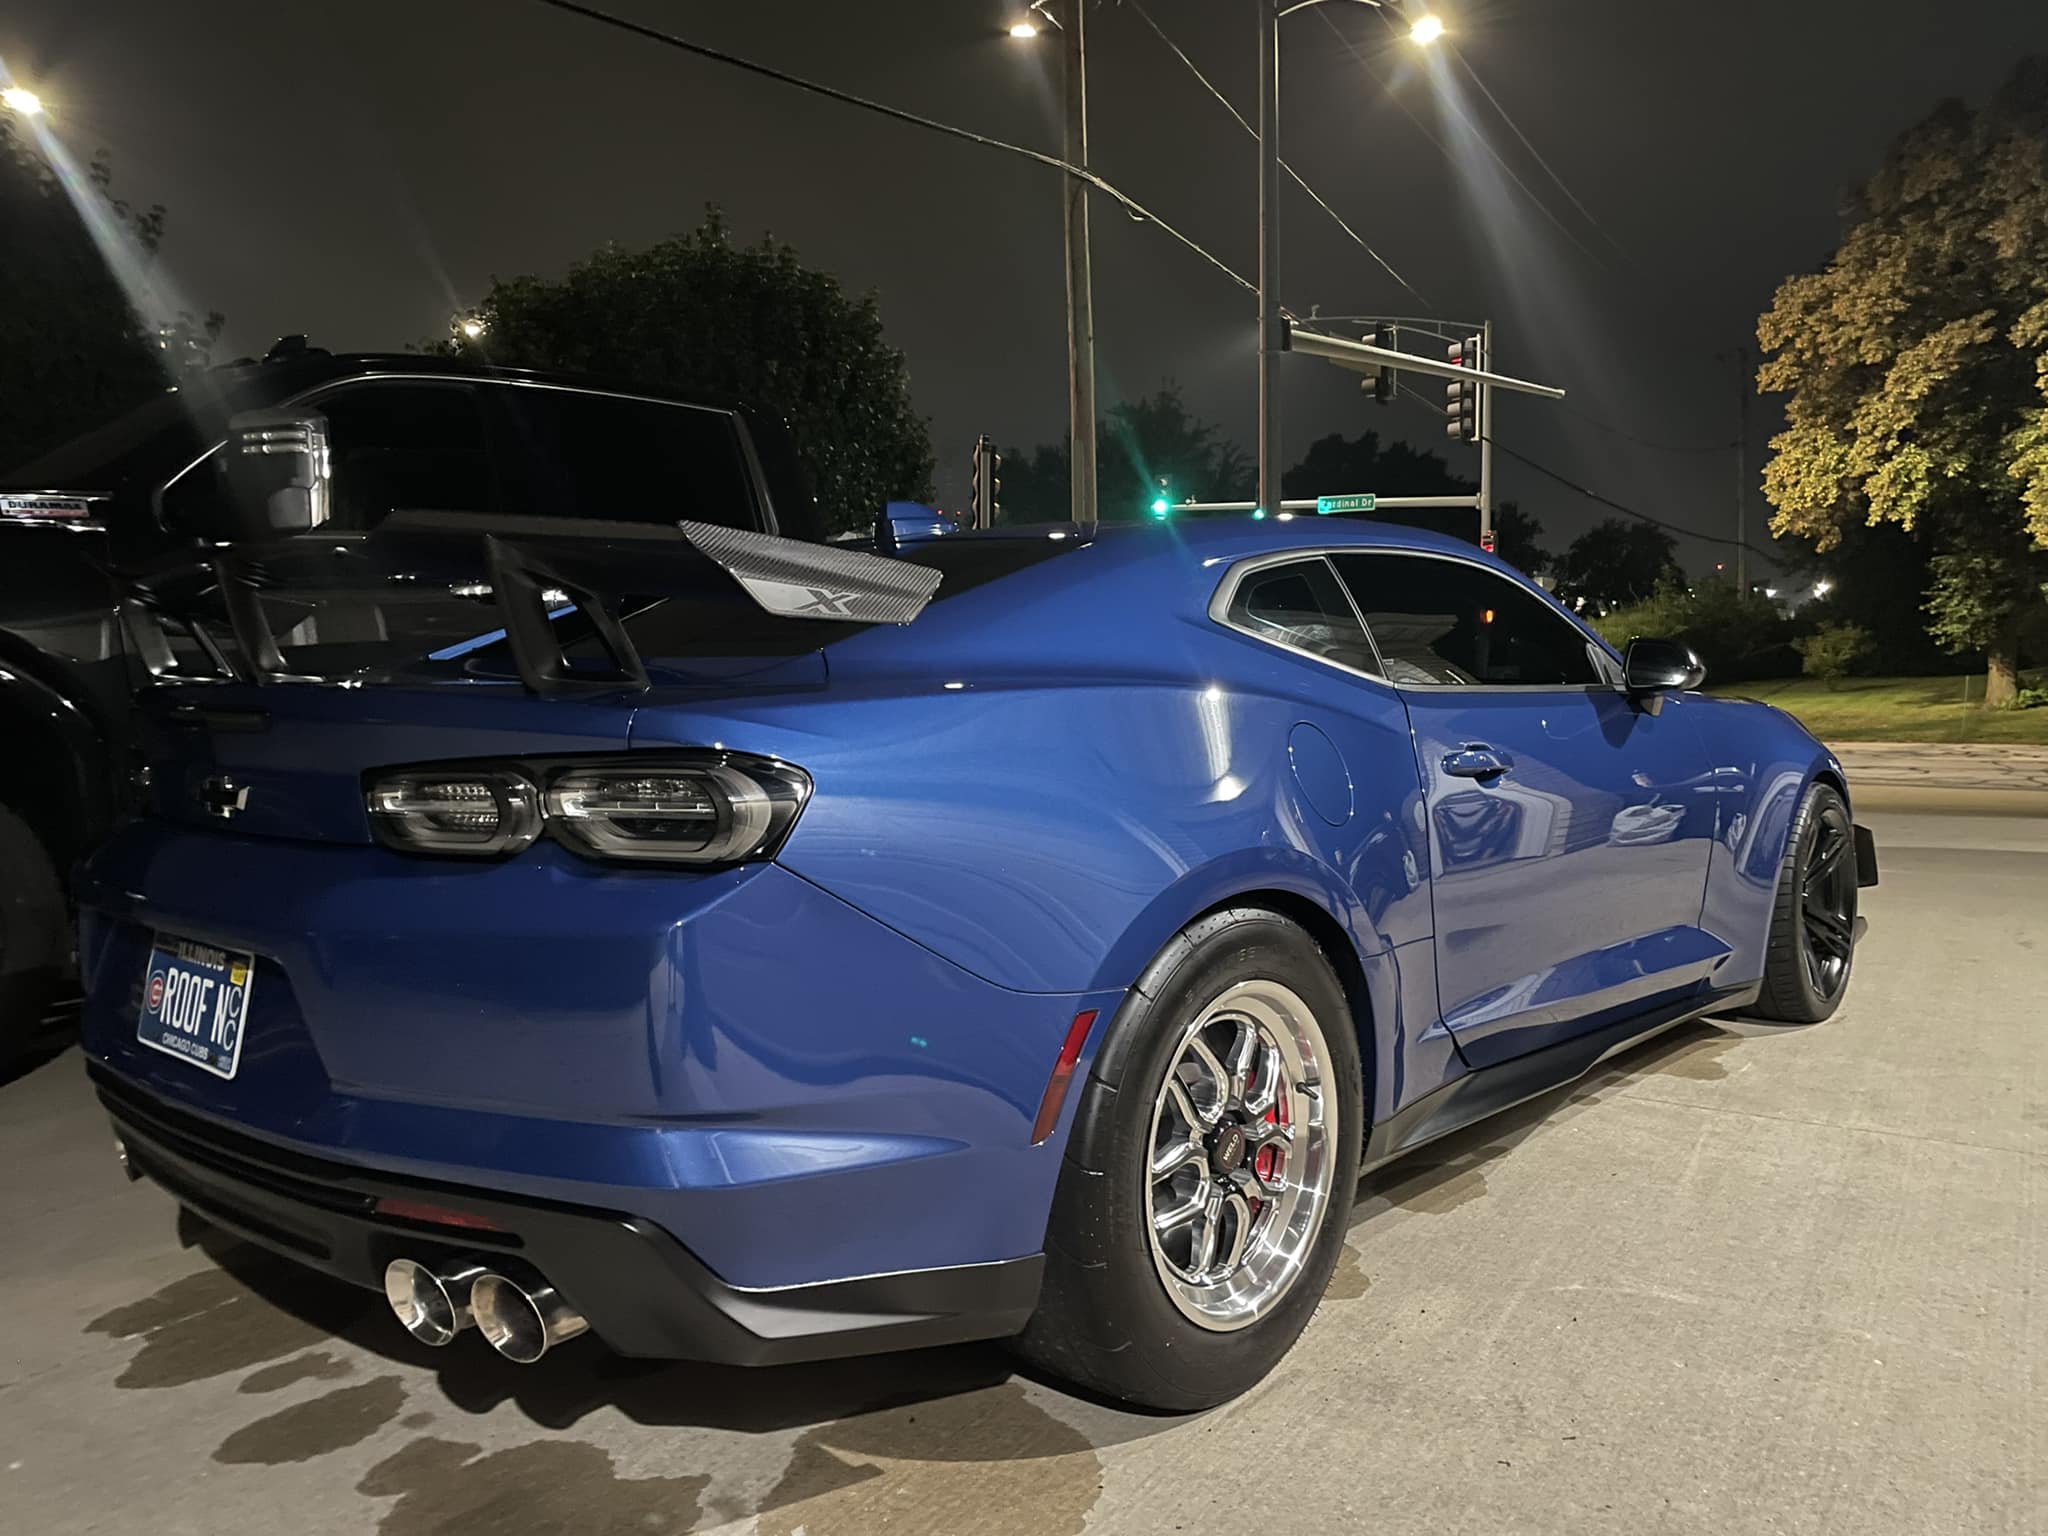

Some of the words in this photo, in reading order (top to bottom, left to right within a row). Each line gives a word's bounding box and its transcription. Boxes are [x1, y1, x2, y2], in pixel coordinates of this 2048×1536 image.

[1361, 498, 1373, 508] Dr
[177, 942, 226, 971] ILLINOIS
[160, 967, 214, 1036] ROOF
[162, 1032, 191, 1053] CHICAGO
[190, 1043, 209, 1061] CUBS
[1223, 1134, 1239, 1160] WELD
